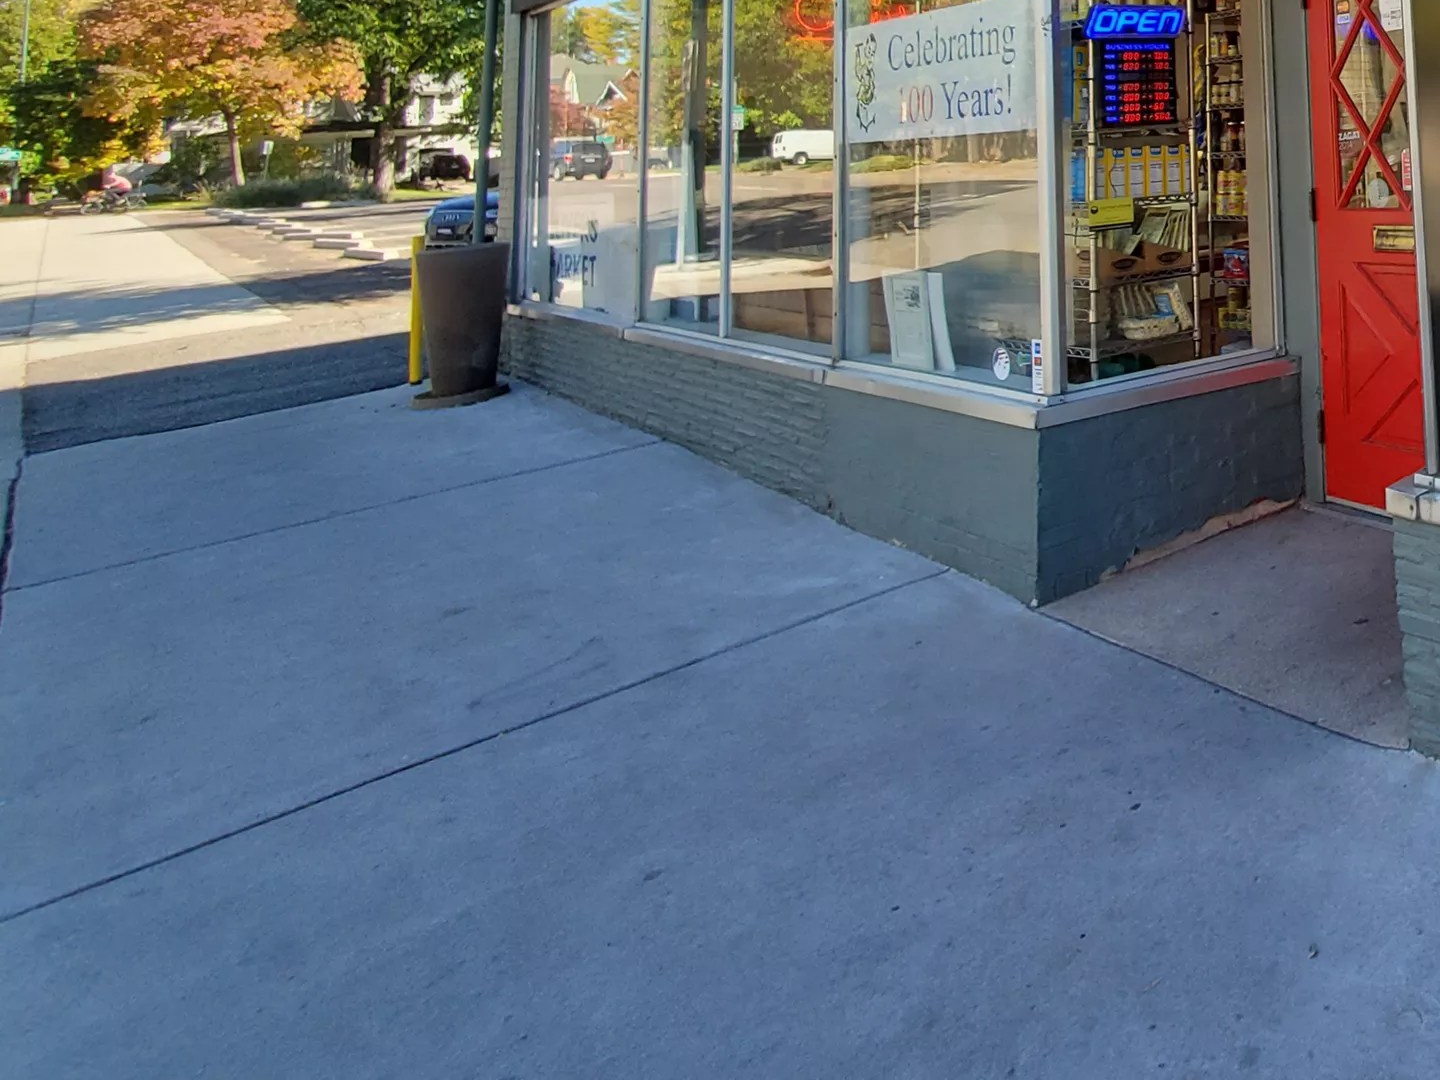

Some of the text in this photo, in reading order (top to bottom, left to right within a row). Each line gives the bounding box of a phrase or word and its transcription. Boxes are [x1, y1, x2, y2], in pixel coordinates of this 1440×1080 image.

[1094, 10, 1181, 33] OPEN
[887, 16, 1016, 72] Celebrating
[899, 73, 1013, 125] 100 Years!
[1338, 130, 1361, 141] ZAGAT
